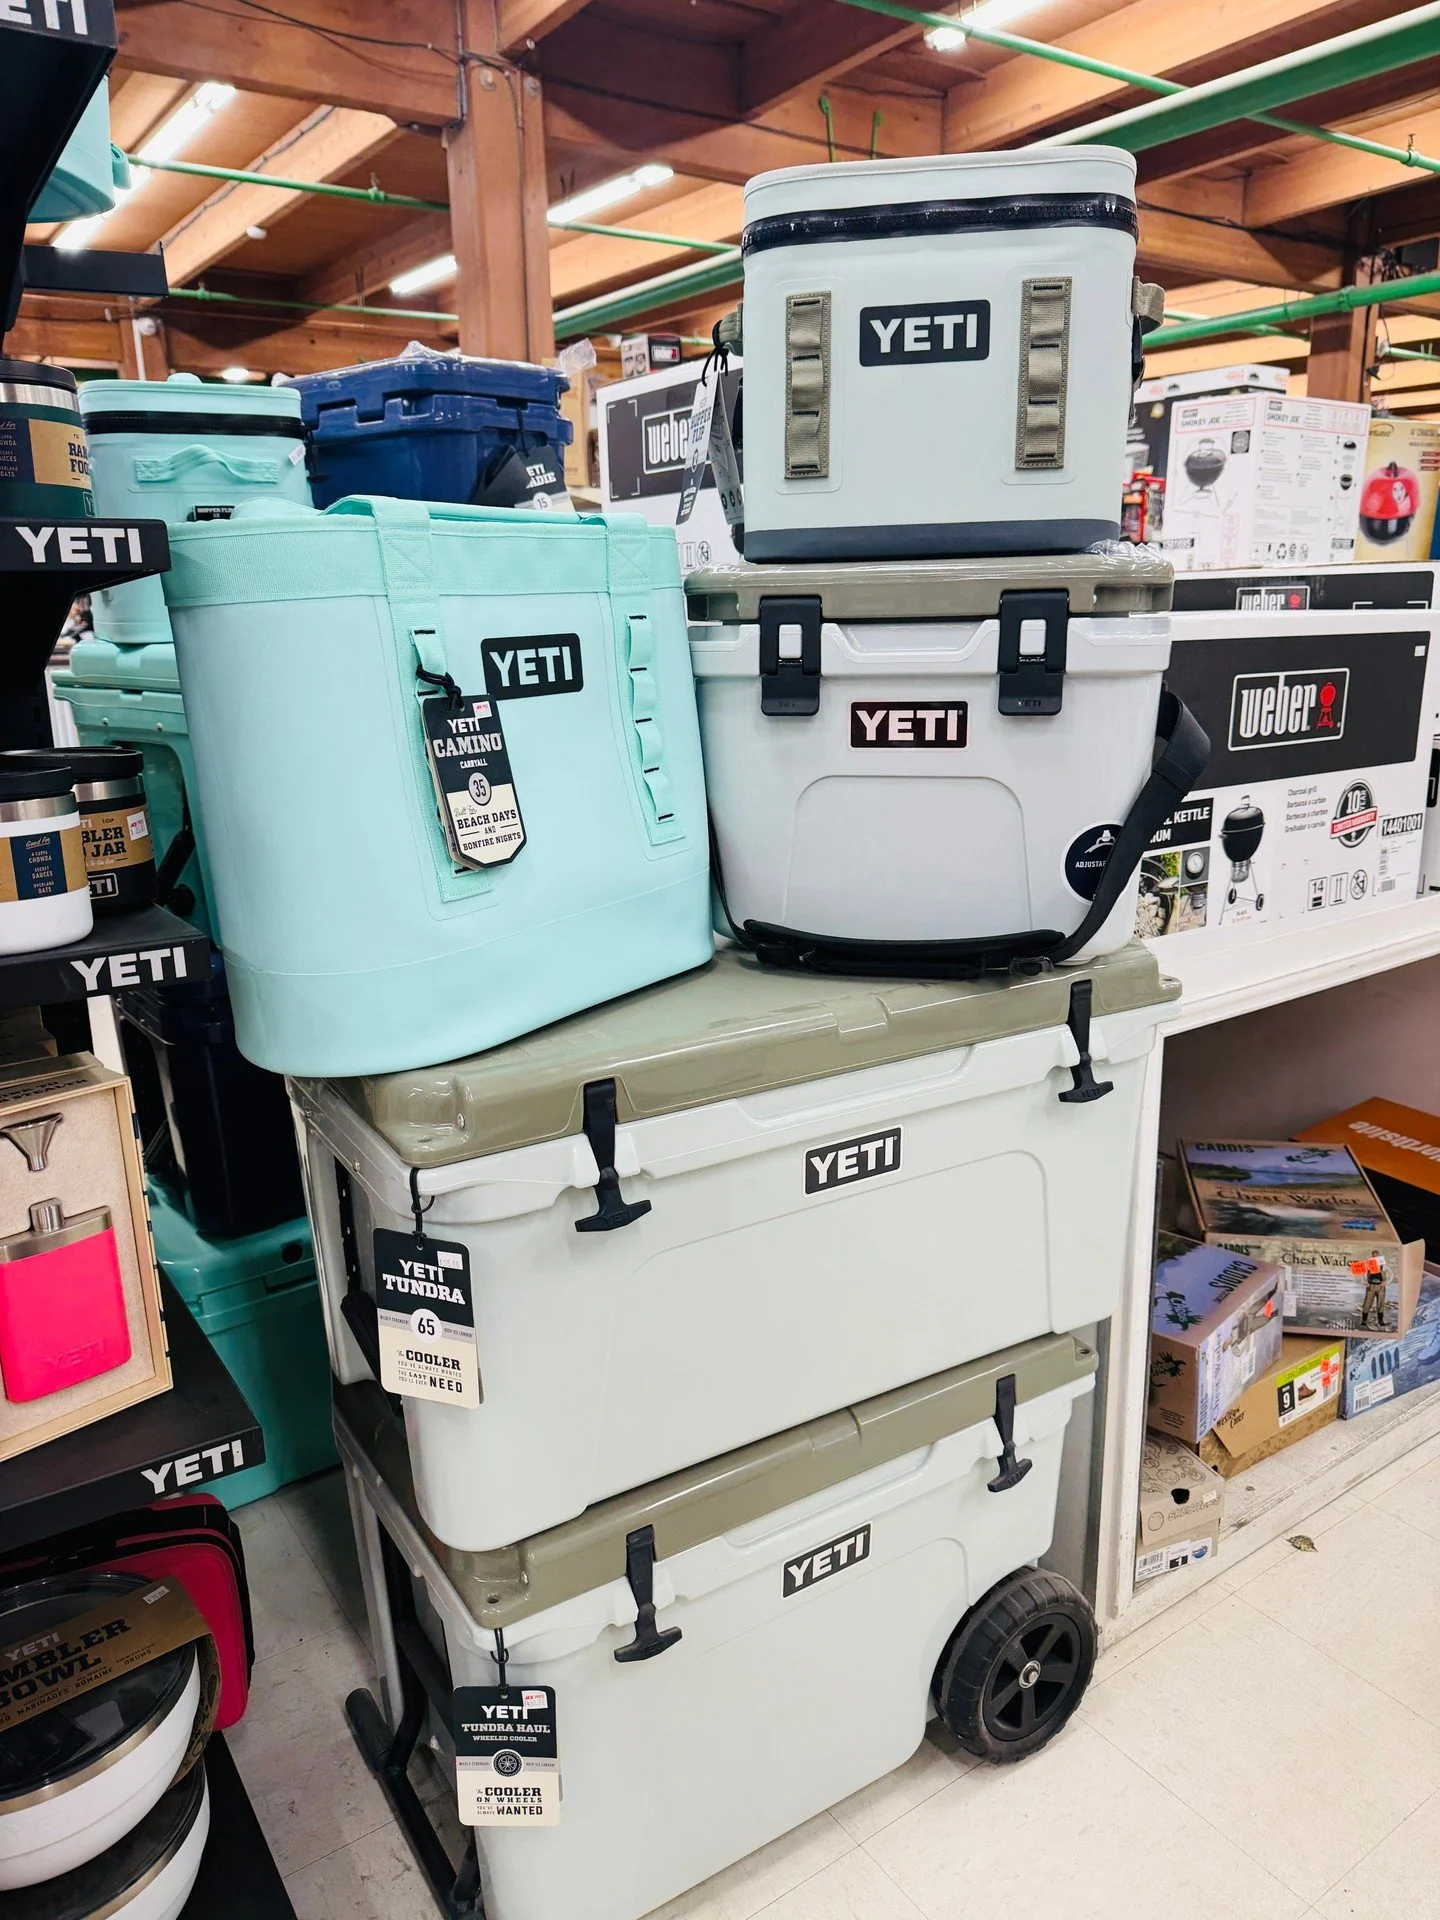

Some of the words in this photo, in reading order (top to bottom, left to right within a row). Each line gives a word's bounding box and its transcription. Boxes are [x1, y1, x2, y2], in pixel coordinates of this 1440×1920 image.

[869, 313, 977, 353] YETI
[537, 497, 548, 510] 15
[15, 526, 143, 563] YETI
[488, 646, 573, 687] YETI
[1239, 674, 1318, 738] weber
[447, 717, 481, 733] YETI
[856, 709, 959, 741] YETI
[433, 732, 502, 758] CAMINO
[460, 759, 488, 769] CARRYALL
[473, 779, 487, 797] 35
[1346, 789, 1360, 814] 10
[457, 814, 490, 829] BEACH
[491, 809, 517, 823] DAYS
[1173, 806, 1211, 824] KETTLE
[484, 825, 496, 835] AND
[1382, 815, 1423, 836] 14401001
[25, 838, 41, 848] Good
[91, 841, 127, 858] JAR
[463, 837, 495, 851] BONFIRE
[495, 831, 522, 845] NIGHTS
[28, 856, 52, 864] CHOWDA
[32, 870, 53, 879] SAUCES
[37, 886, 52, 894] OATS
[1312, 880, 1325, 894] 14
[70, 946, 187, 991] YETI
[1195, 1142, 1254, 1153] CADDIS
[810, 1136, 894, 1185] YETI
[1216, 1190, 1282, 1203] Chest
[1287, 1193, 1360, 1205] Wader
[1281, 1252, 1317, 1265] Chest
[399, 1259, 443, 1283] YETI
[1208, 1260, 1258, 1292] CADDIS
[382, 1273, 466, 1306] TUNDRA
[417, 1317, 435, 1336] 65
[405, 1349, 462, 1371] COOLER
[408, 1372, 427, 1380] LAST
[417, 1363, 439, 1373] ALWAYS
[440, 1367, 462, 1378] WANTED
[429, 1375, 463, 1394] NEED
[1283, 1392, 1290, 1409] 9
[141, 1439, 245, 1495] YETI
[787, 1532, 864, 1588] YETI
[4, 1632, 61, 1662] YETI
[75, 1667, 113, 1689] ROMAINE
[17, 1688, 70, 1715] MARINADES
[481, 1705, 528, 1719] YETI
[461, 1723, 514, 1732] TUNDRA
[516, 1724, 550, 1733] HAUL
[484, 1787, 542, 1796] COOLER
[496, 1806, 543, 1815] WANTED
